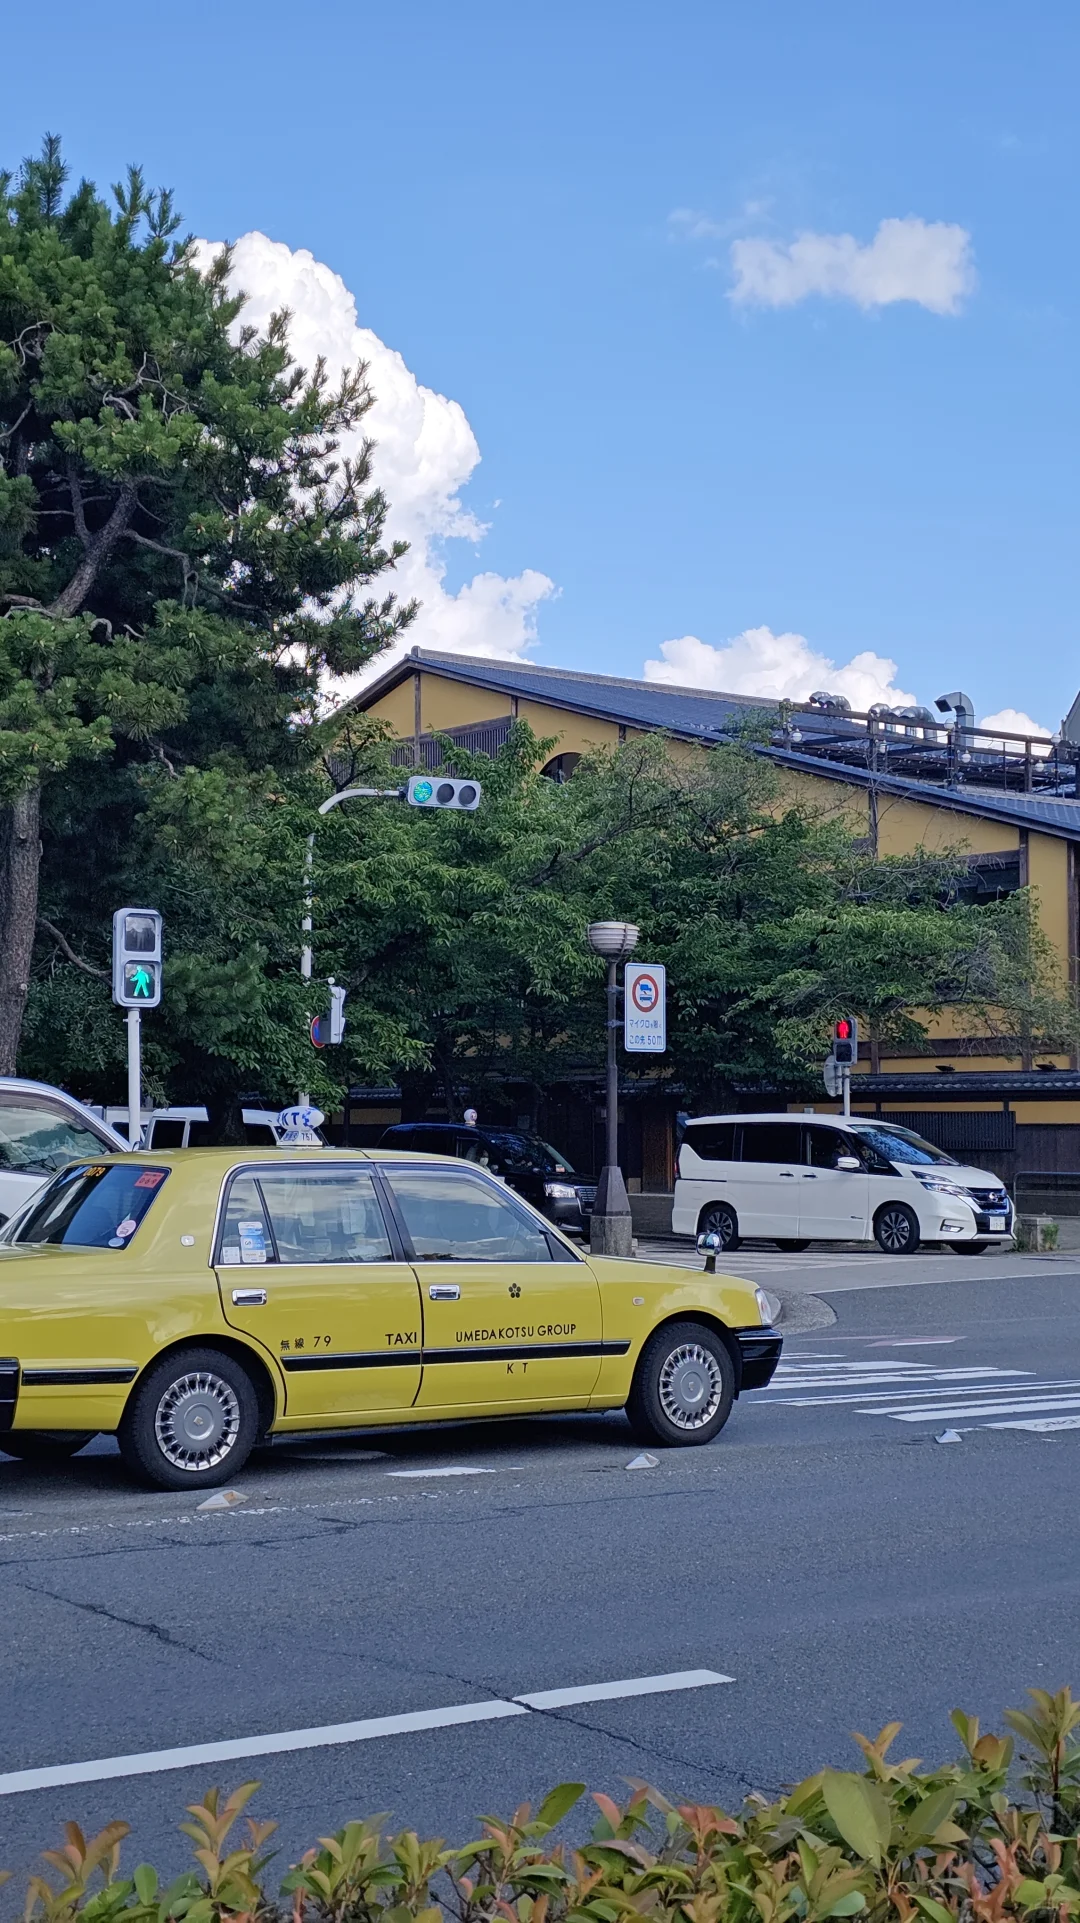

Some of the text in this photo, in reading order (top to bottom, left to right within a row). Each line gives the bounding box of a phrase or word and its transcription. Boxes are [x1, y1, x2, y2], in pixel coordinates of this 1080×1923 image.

[385, 1332, 417, 1346] TAXI
[455, 1323, 577, 1343] UMEDAKOTSU GROUP
[313, 1335, 332, 1348] 79
